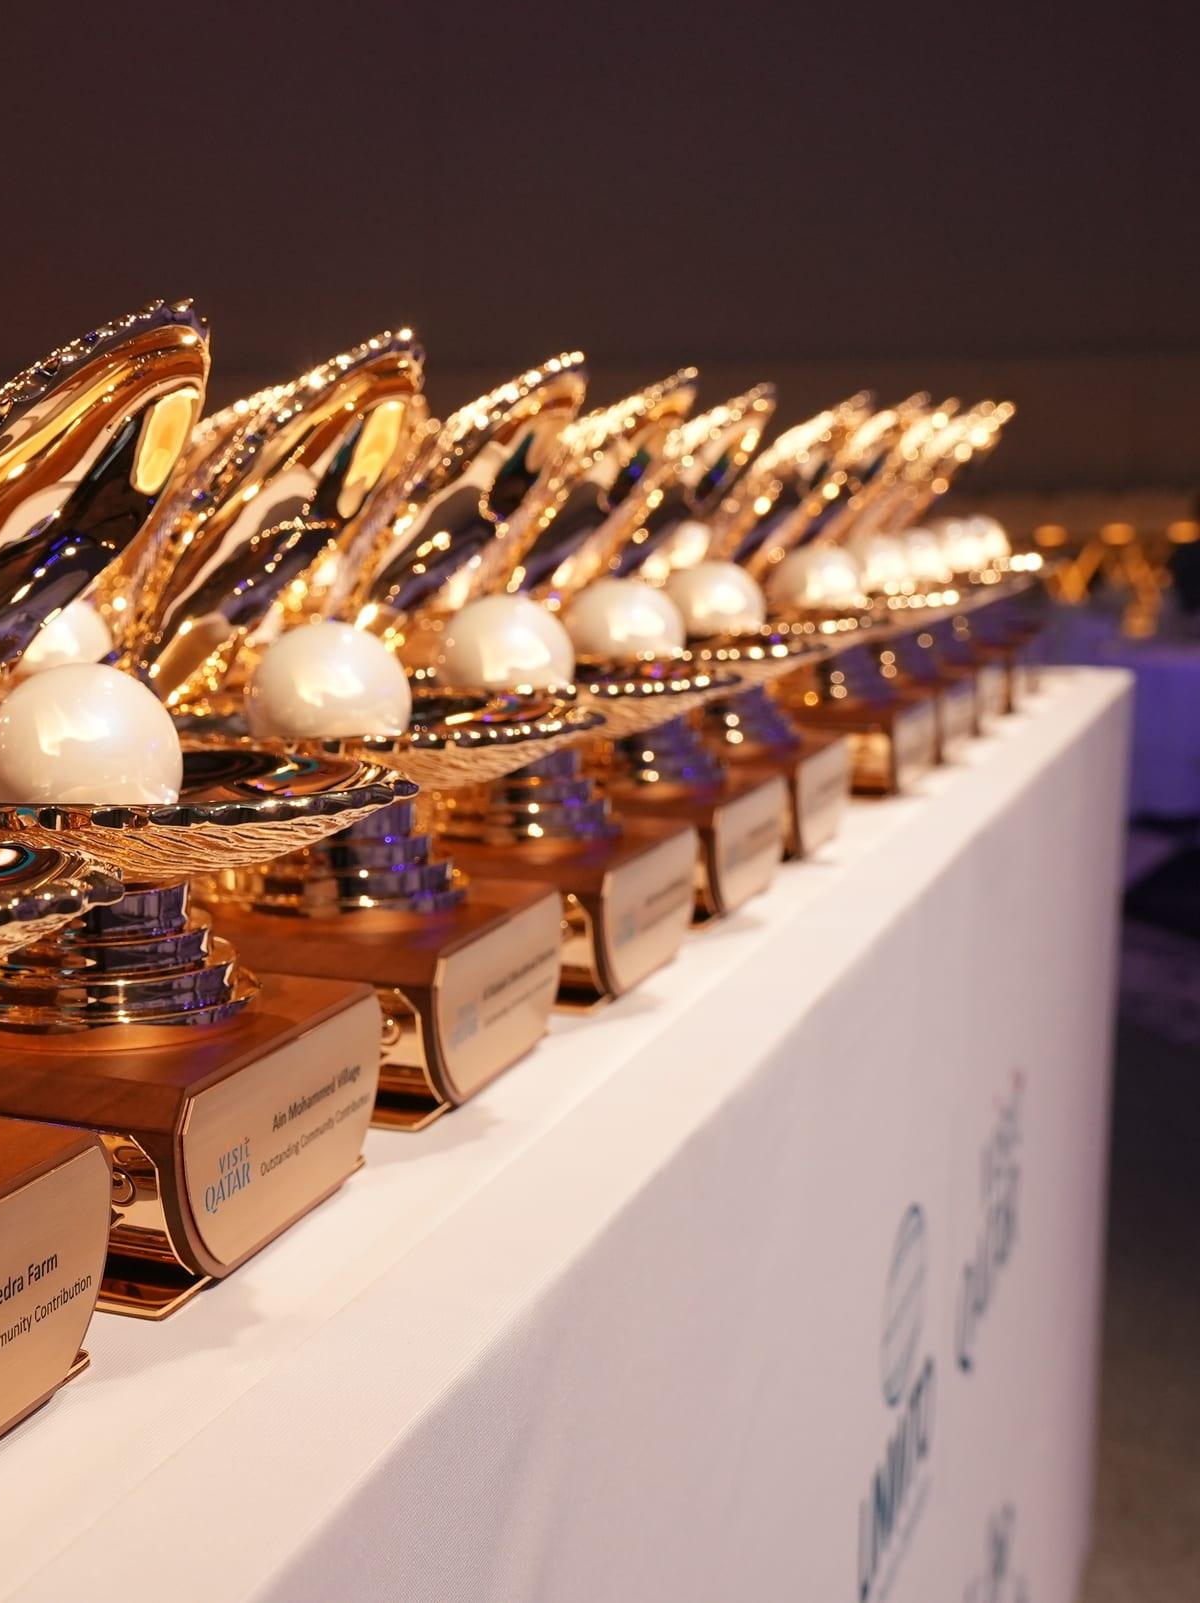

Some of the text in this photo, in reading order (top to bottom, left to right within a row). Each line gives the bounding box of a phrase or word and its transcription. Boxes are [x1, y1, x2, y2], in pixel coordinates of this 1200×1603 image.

[204, 1162, 252, 1214] QATAR
[27, 1253, 59, 1286] Farm
[34, 1274, 93, 1323] Contribution
